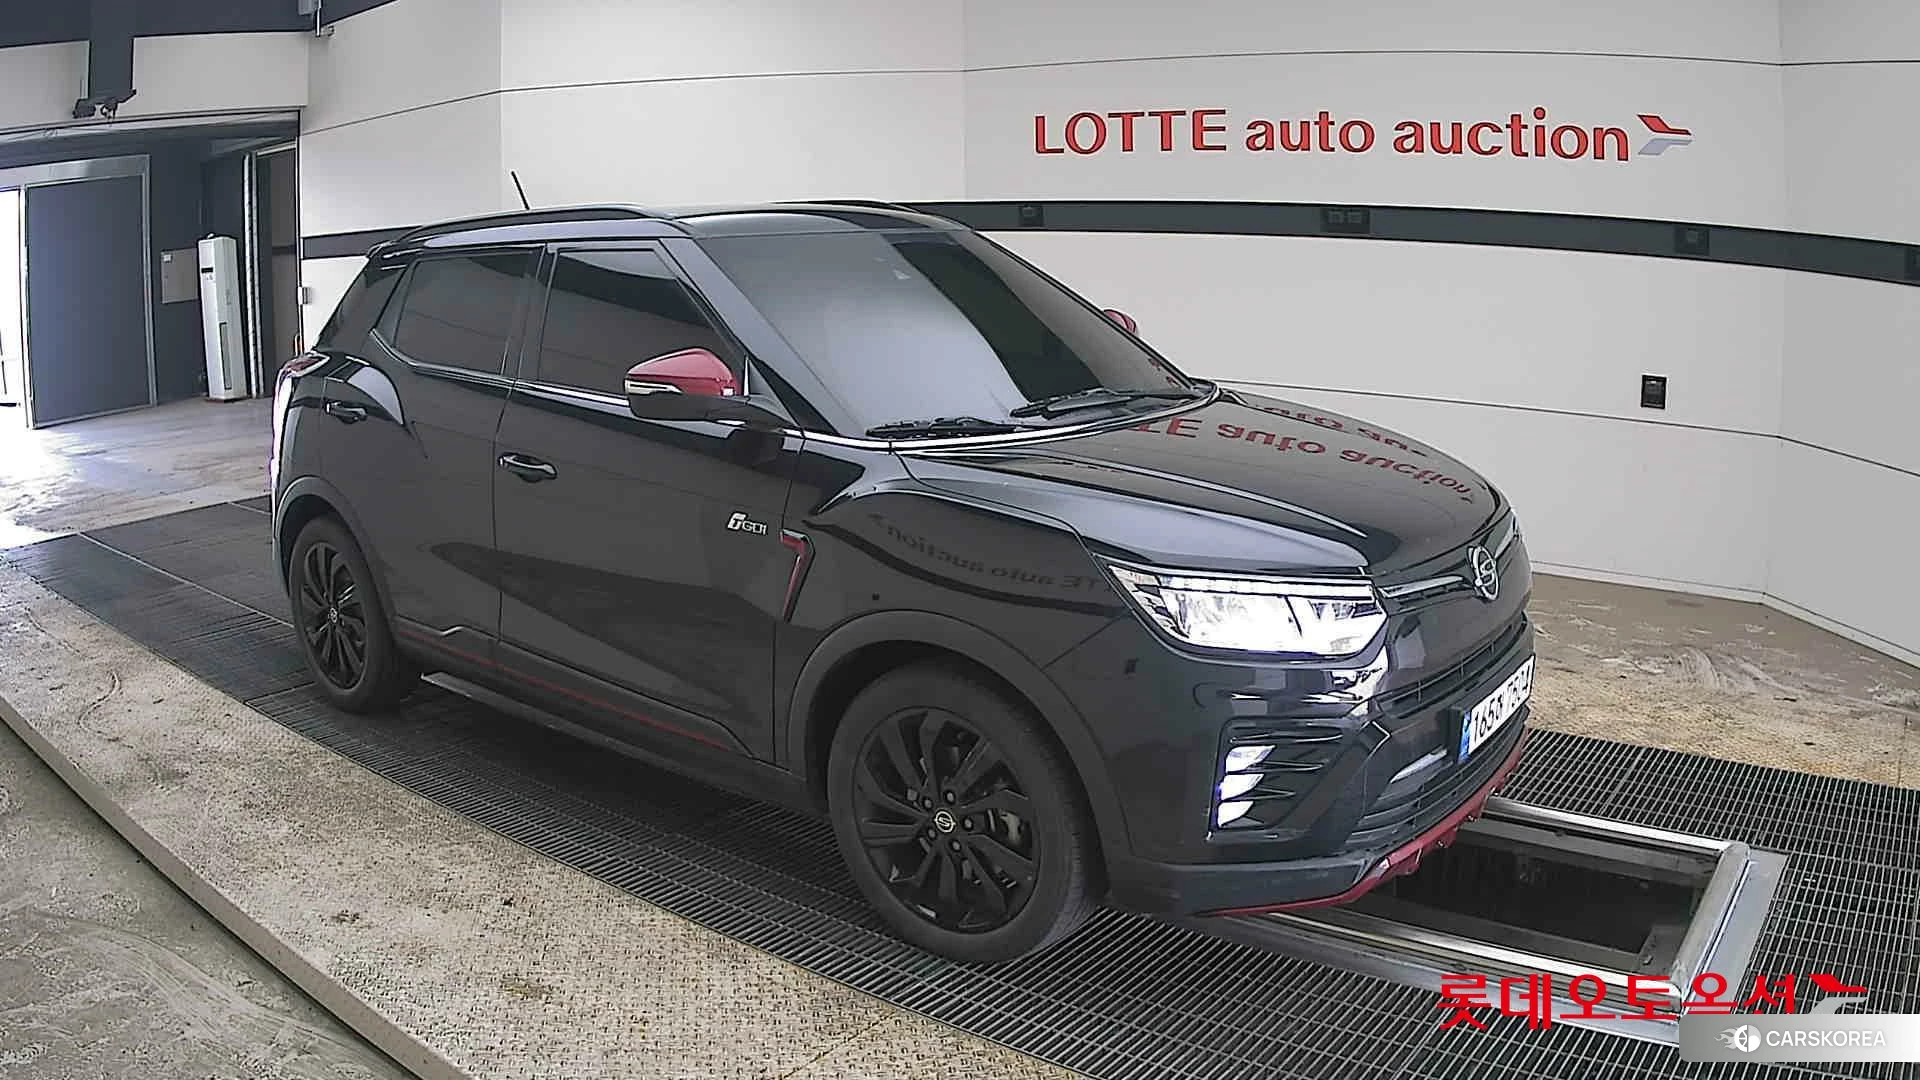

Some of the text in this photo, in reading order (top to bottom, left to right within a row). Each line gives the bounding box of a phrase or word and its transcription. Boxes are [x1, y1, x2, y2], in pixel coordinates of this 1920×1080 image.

[1035, 106, 1629, 162] LOTTE auto auction
